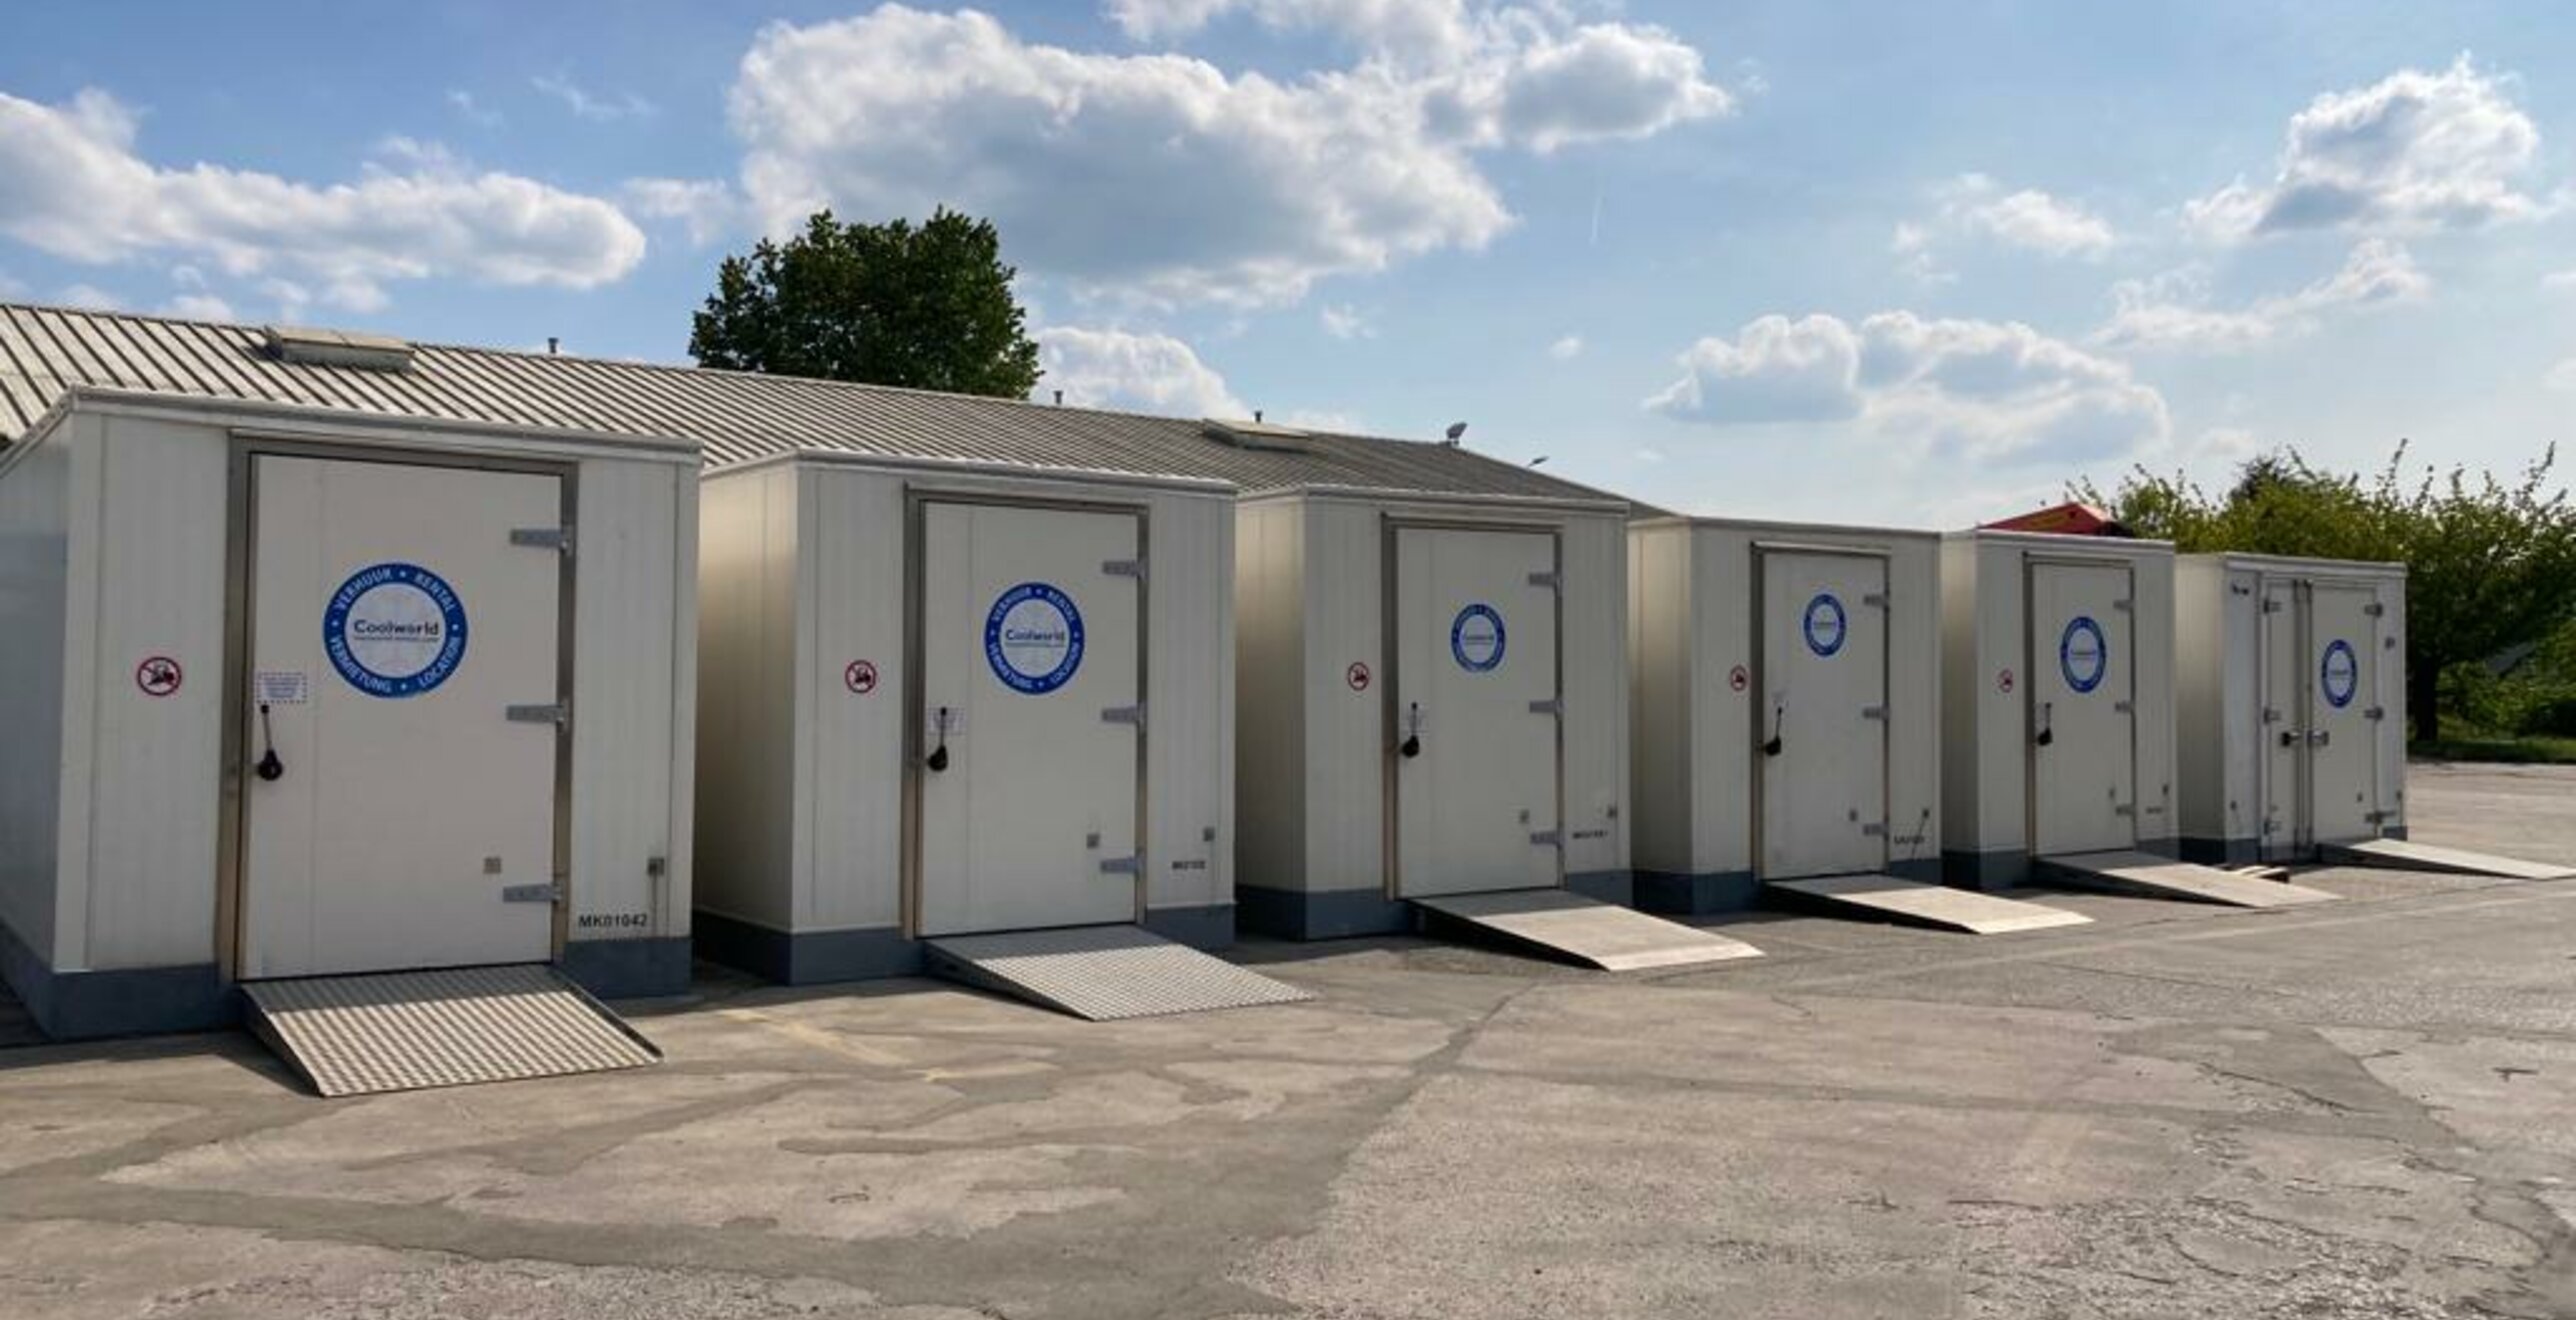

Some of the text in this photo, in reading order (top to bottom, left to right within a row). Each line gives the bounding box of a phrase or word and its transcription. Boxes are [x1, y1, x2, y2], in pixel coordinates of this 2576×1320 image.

[413, 572, 455, 613] RENTAL
[353, 619, 439, 636] Coolworld
[329, 634, 393, 694] VERMIETUNG
[416, 636, 462, 688] LOCATION
